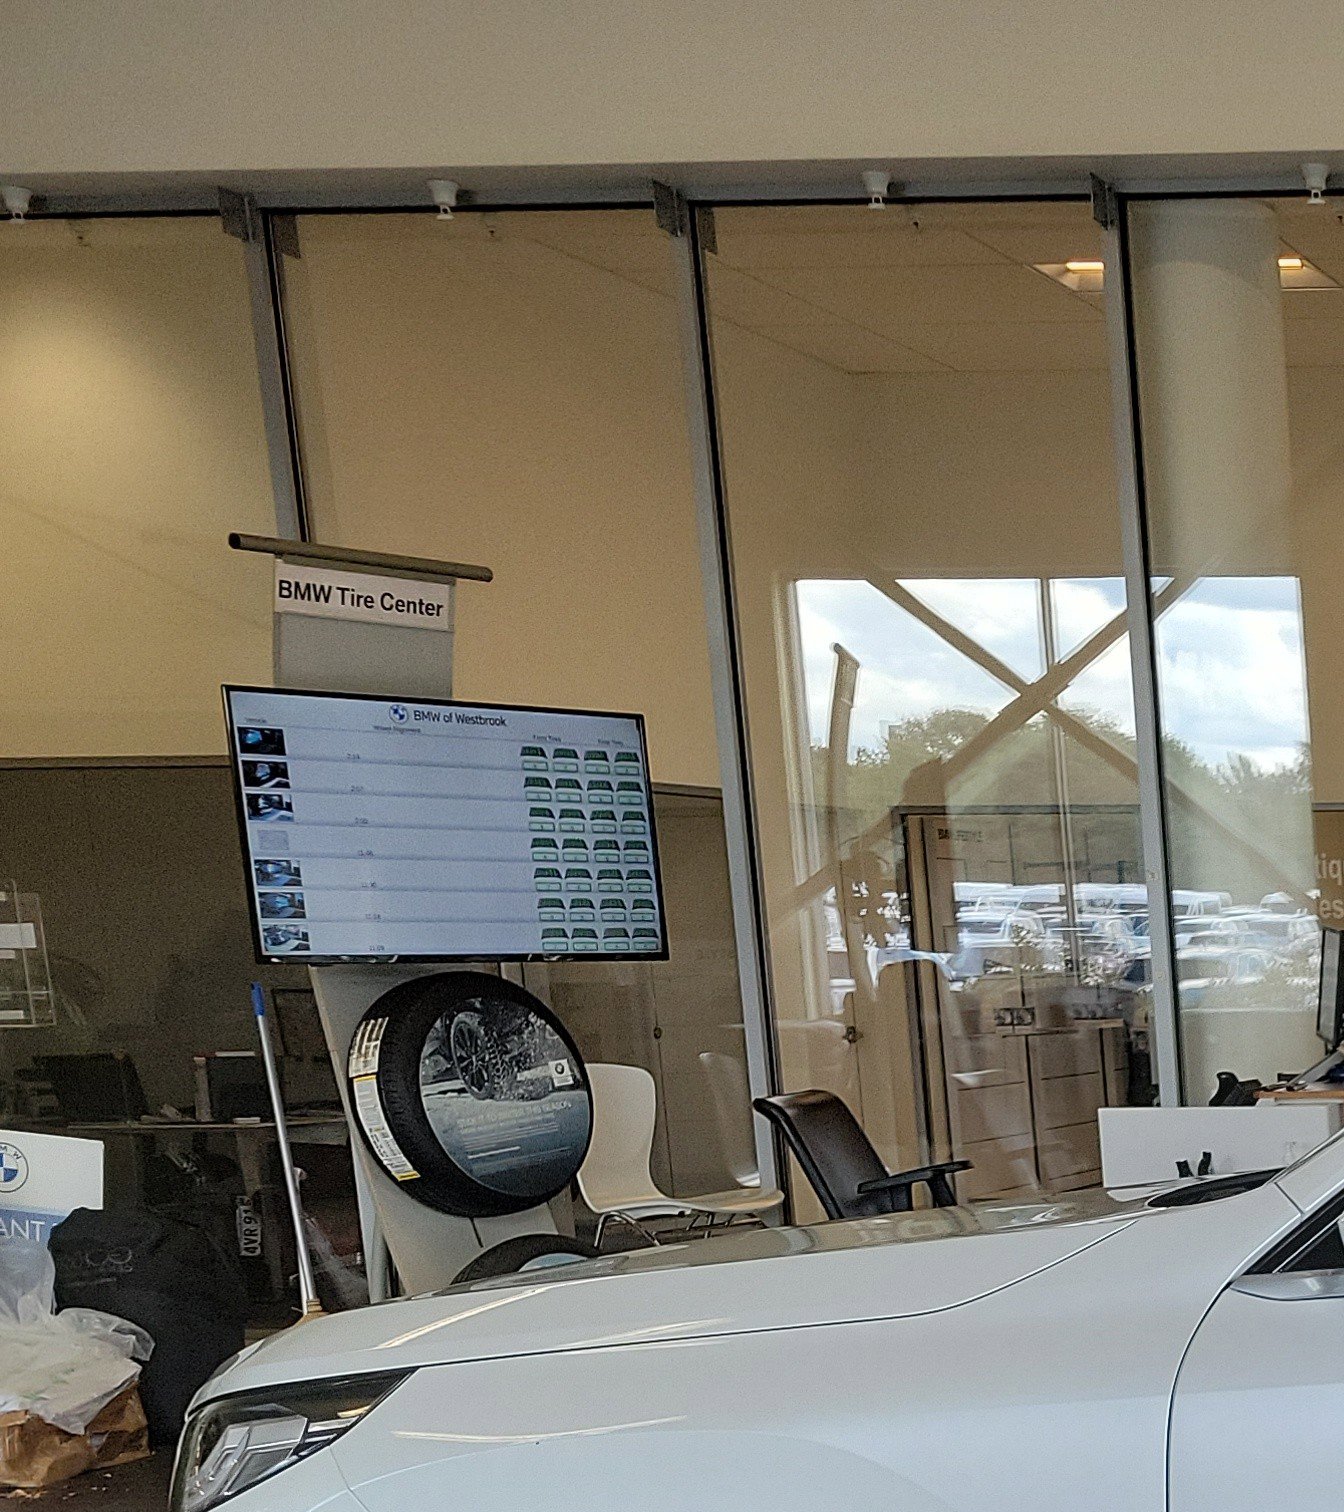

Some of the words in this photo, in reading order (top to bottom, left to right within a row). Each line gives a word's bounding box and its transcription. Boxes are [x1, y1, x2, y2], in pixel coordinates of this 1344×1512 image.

[278, 579, 332, 604] BMW
[336, 586, 375, 609] Tire
[380, 592, 444, 617] Center
[413, 709, 441, 722] BMW
[443, 711, 453, 723] of
[455, 713, 508, 727] Westbrook
